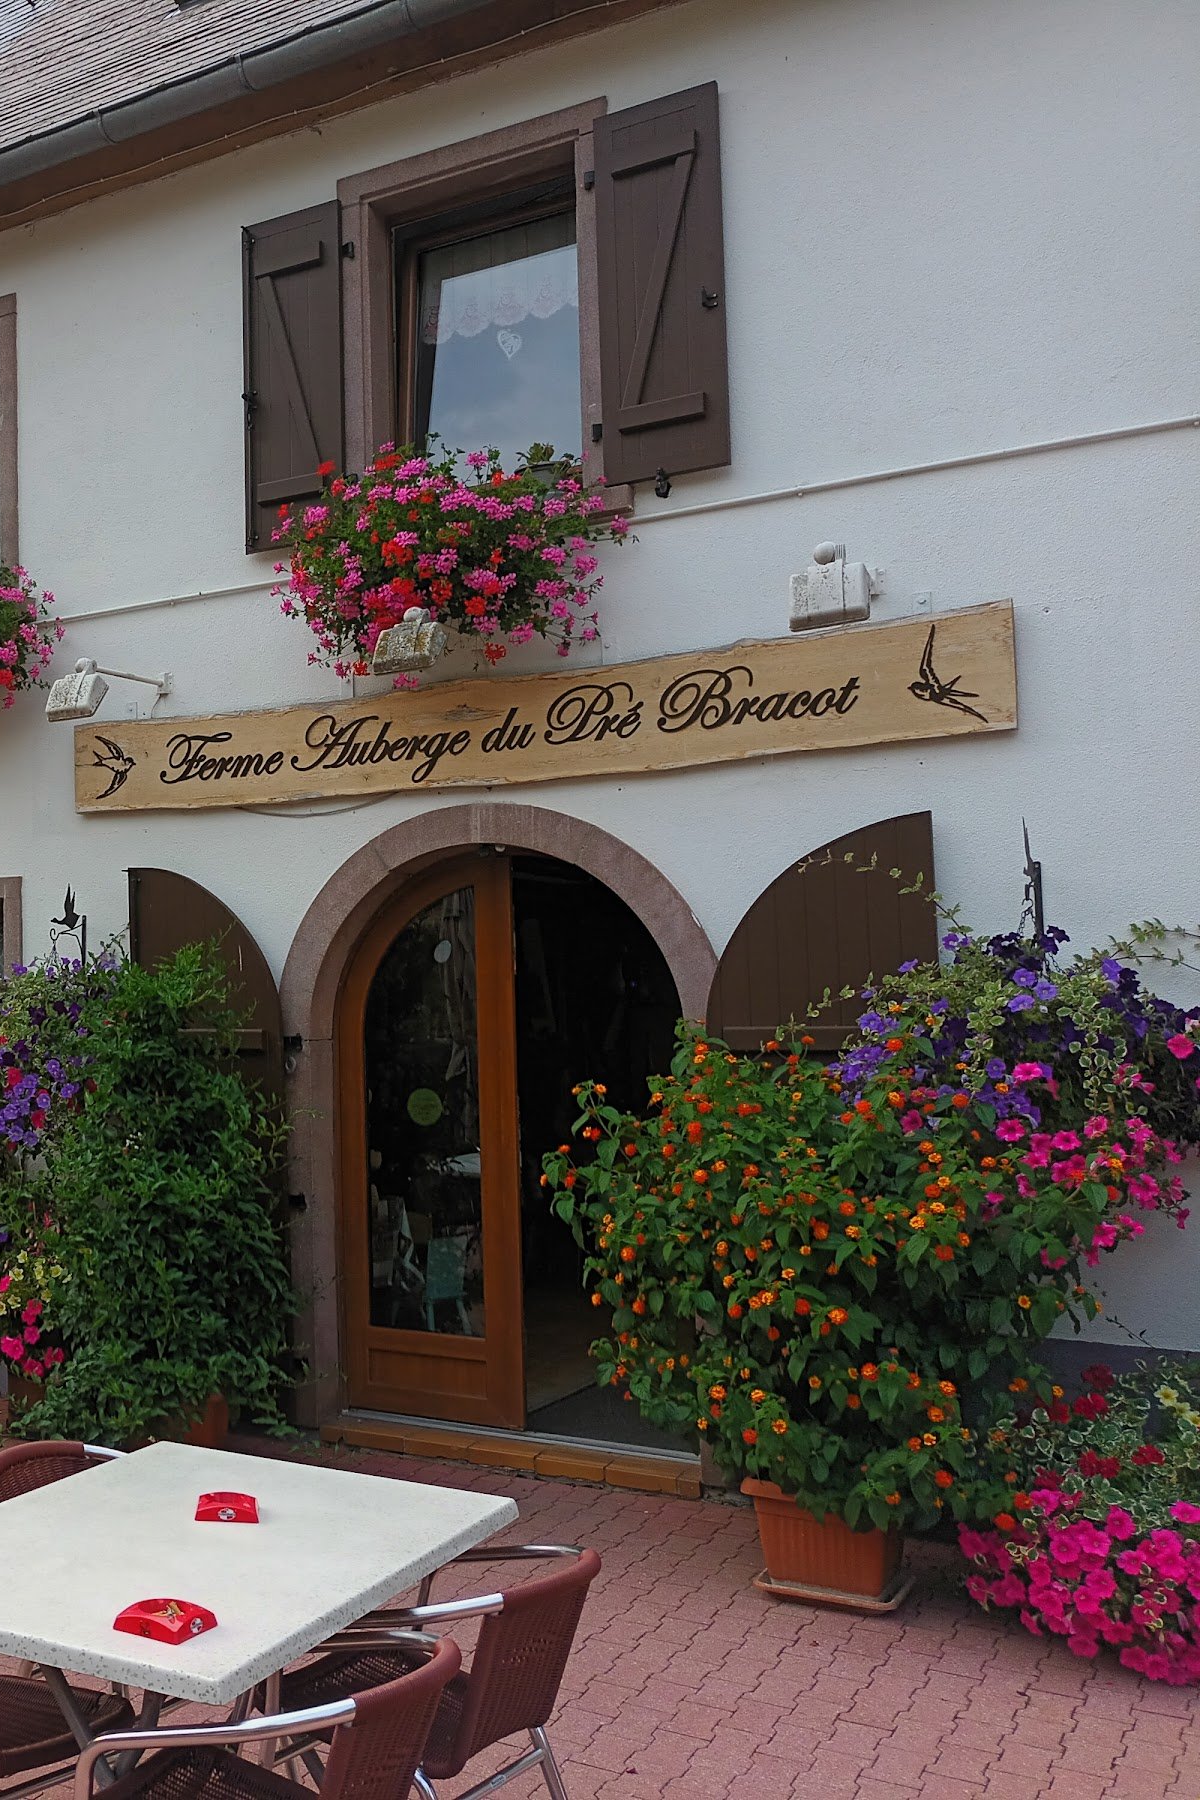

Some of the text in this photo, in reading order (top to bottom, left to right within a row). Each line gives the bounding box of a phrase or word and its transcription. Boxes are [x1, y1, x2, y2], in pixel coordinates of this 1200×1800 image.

[160, 665, 860, 784] Ferme Auberge du Pré Bracot
